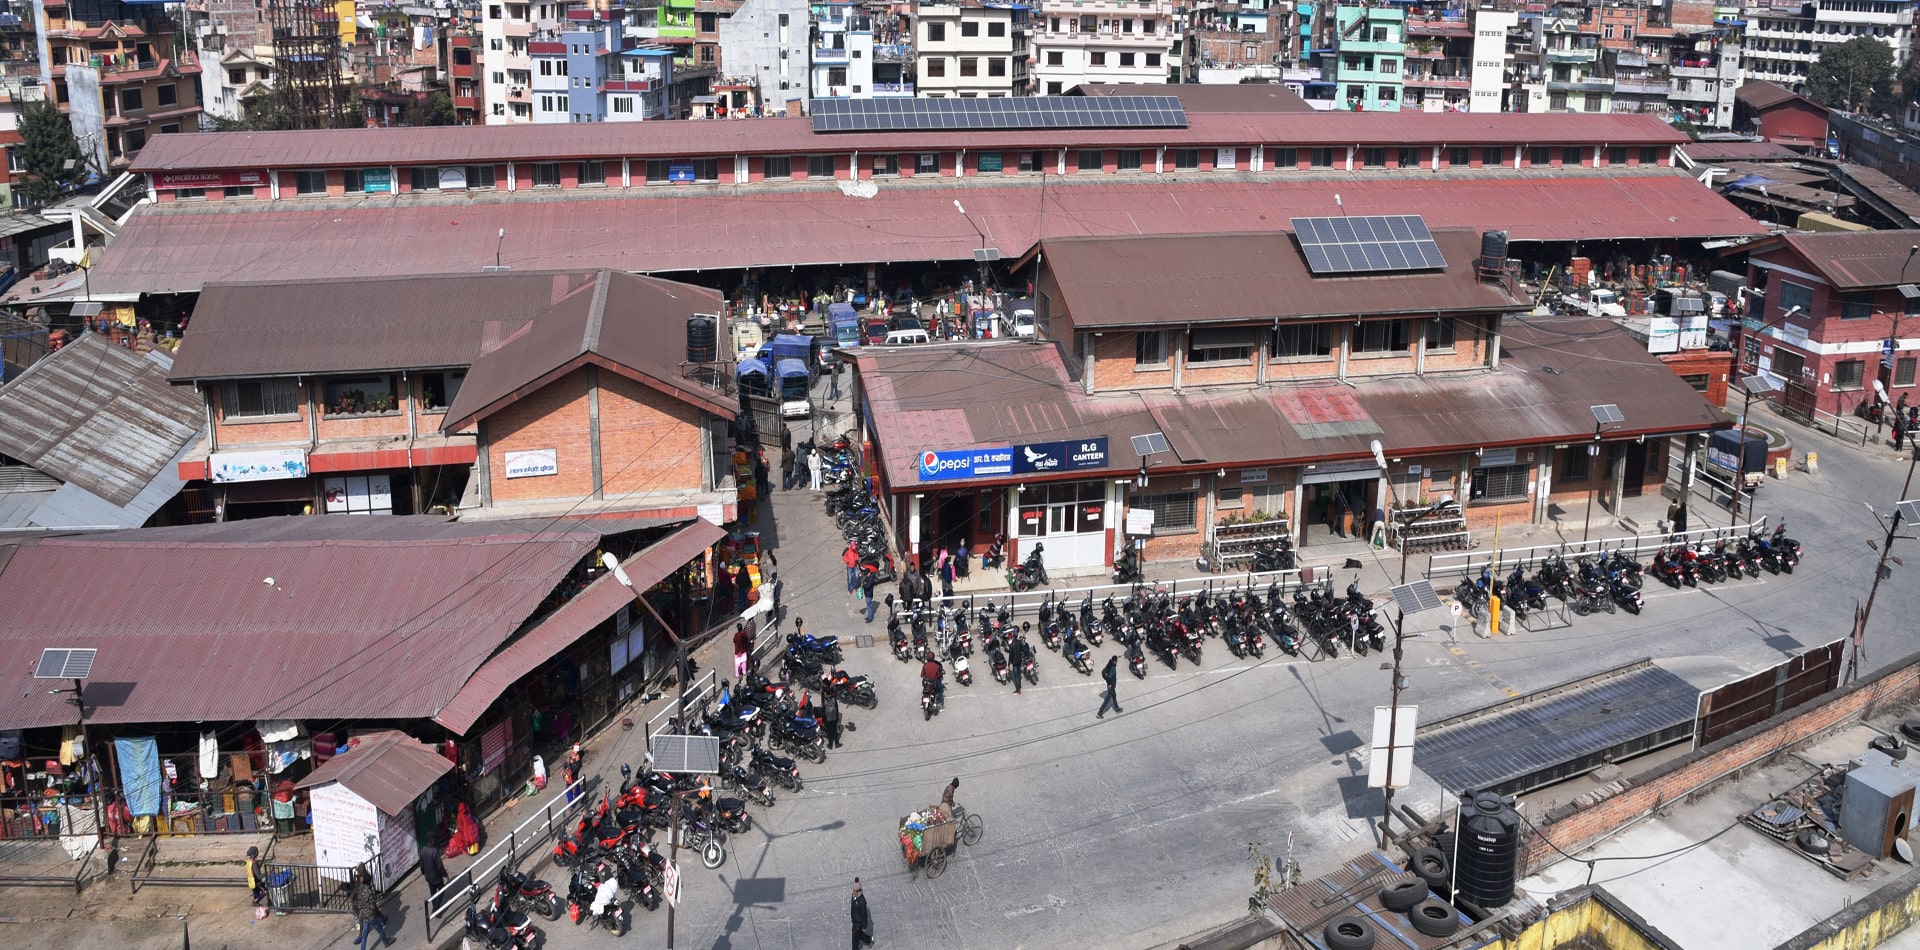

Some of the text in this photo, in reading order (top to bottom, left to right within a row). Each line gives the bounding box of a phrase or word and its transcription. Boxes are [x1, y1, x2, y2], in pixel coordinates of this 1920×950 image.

[1081, 443, 1097, 452] R.G
[1072, 451, 1104, 461] CANTEEN
[939, 456, 970, 471] pepsi
